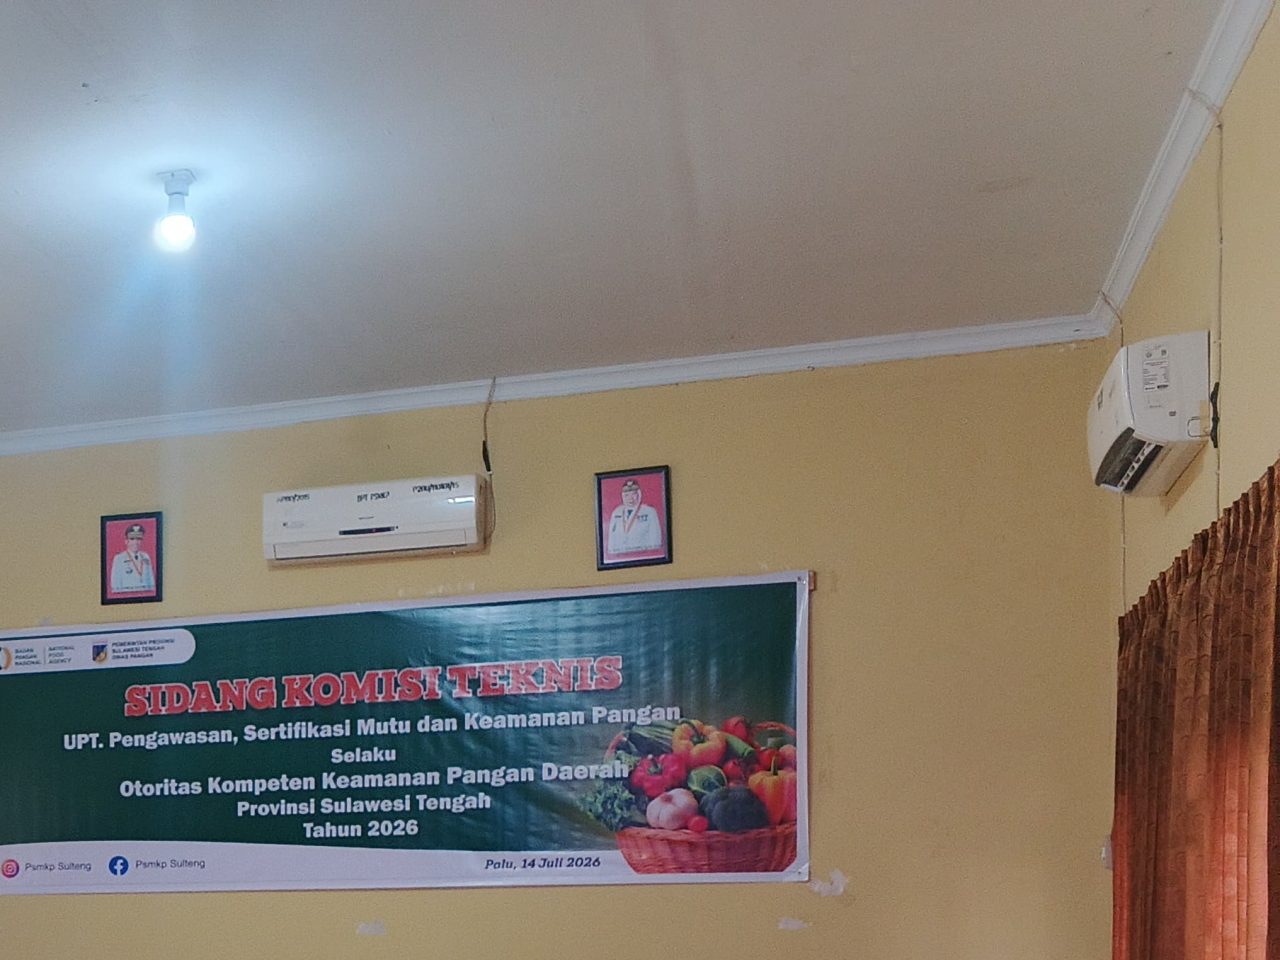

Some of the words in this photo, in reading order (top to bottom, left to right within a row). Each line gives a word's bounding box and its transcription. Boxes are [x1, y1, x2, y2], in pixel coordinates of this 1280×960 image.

[124, 676, 277, 717] SIDANG
[282, 666, 442, 708] KOMISI
[447, 656, 623, 698] TEKNIS
[63, 733, 104, 750] UPT.
[109, 728, 238, 750] Pengawasan,
[244, 719, 351, 742] Sertifikasi
[357, 716, 411, 736] Mutu
[417, 714, 457, 733] dan
[464, 709, 585, 730] Keamanan
[592, 704, 681, 726] Pangan
[331, 746, 397, 764] Selaku
[120, 779, 202, 798] Otoritas
[208, 774, 316, 796] Kompeten
[322, 770, 440, 790] Keamanan
[446, 766, 535, 787] Pangan
[542, 760, 629, 781] Daerah
[237, 799, 315, 817] Provinsi
[320, 795, 410, 814] Sulawesi
[416, 792, 491, 813] Tengah
[303, 821, 362, 838] Tahun
[367, 819, 419, 837] 2026
[25, 862, 55, 872] Psmkp
[57, 861, 92, 872] Sulteng
[135, 860, 167, 869] Psmkp
[169, 859, 206, 870] Sulteng
[484, 858, 517, 870] Palu,
[521, 858, 536, 869] 14
[538, 857, 563, 869] Juli
[566, 857, 601, 868] 2026
